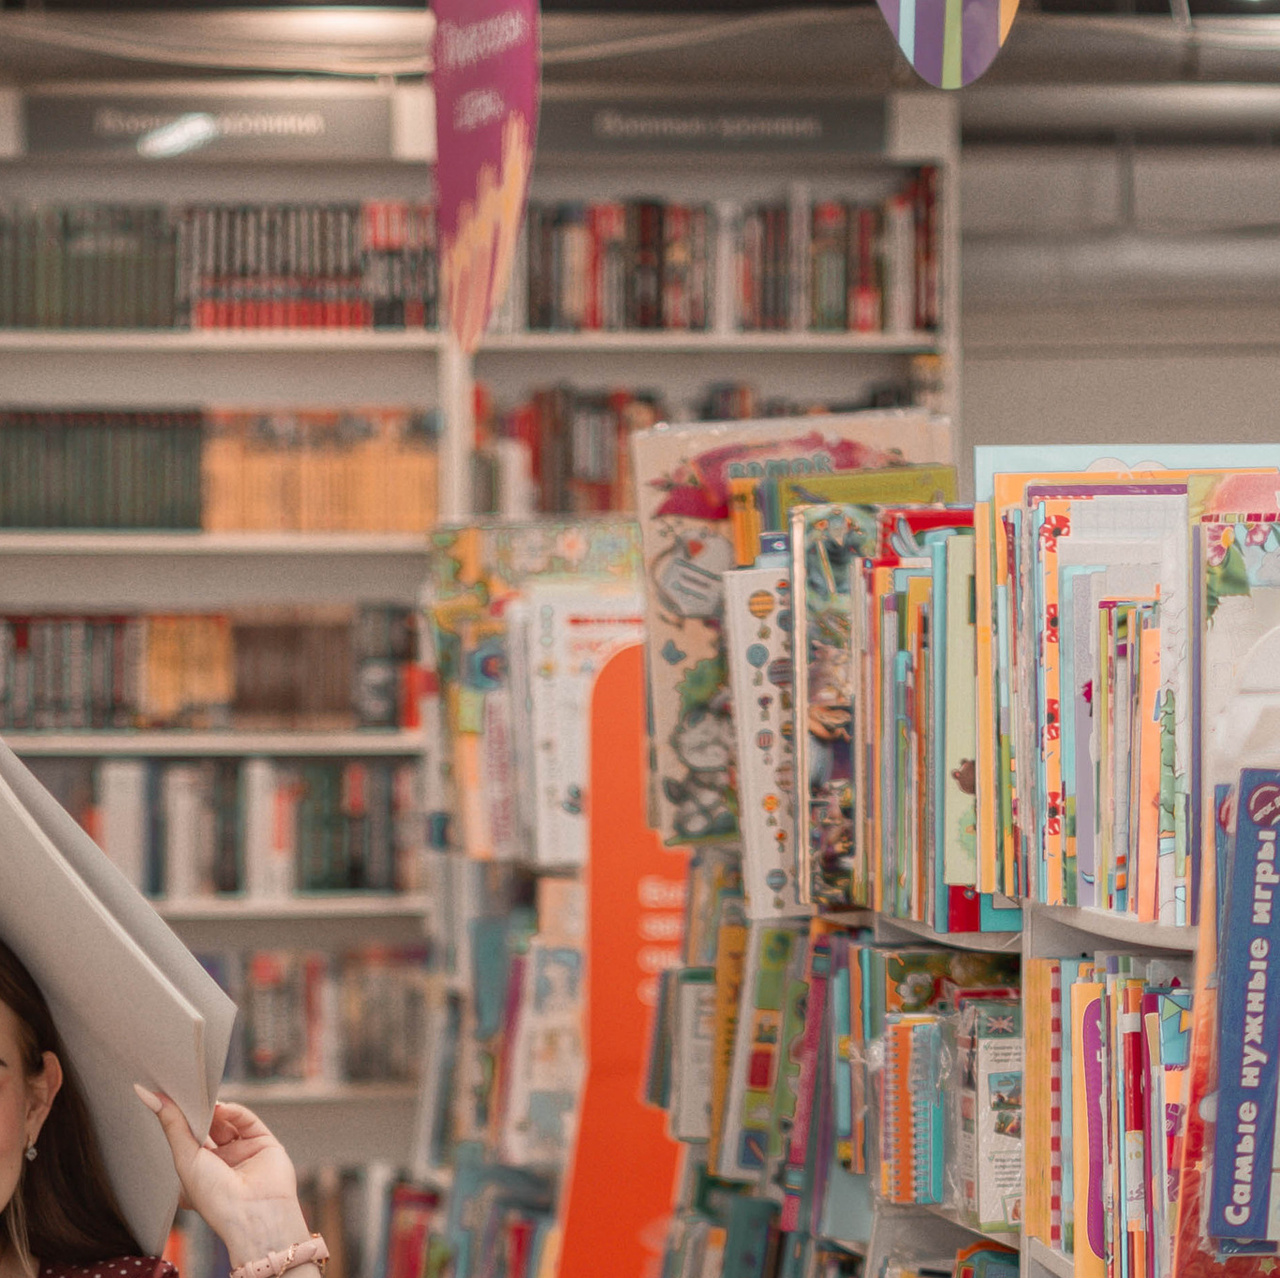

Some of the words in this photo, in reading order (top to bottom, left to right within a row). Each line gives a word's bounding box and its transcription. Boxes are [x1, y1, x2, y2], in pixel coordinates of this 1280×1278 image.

[1252, 830, 1278, 924] игры
[1241, 938, 1269, 1087] нужные
[1224, 1100, 1258, 1227] Самые
